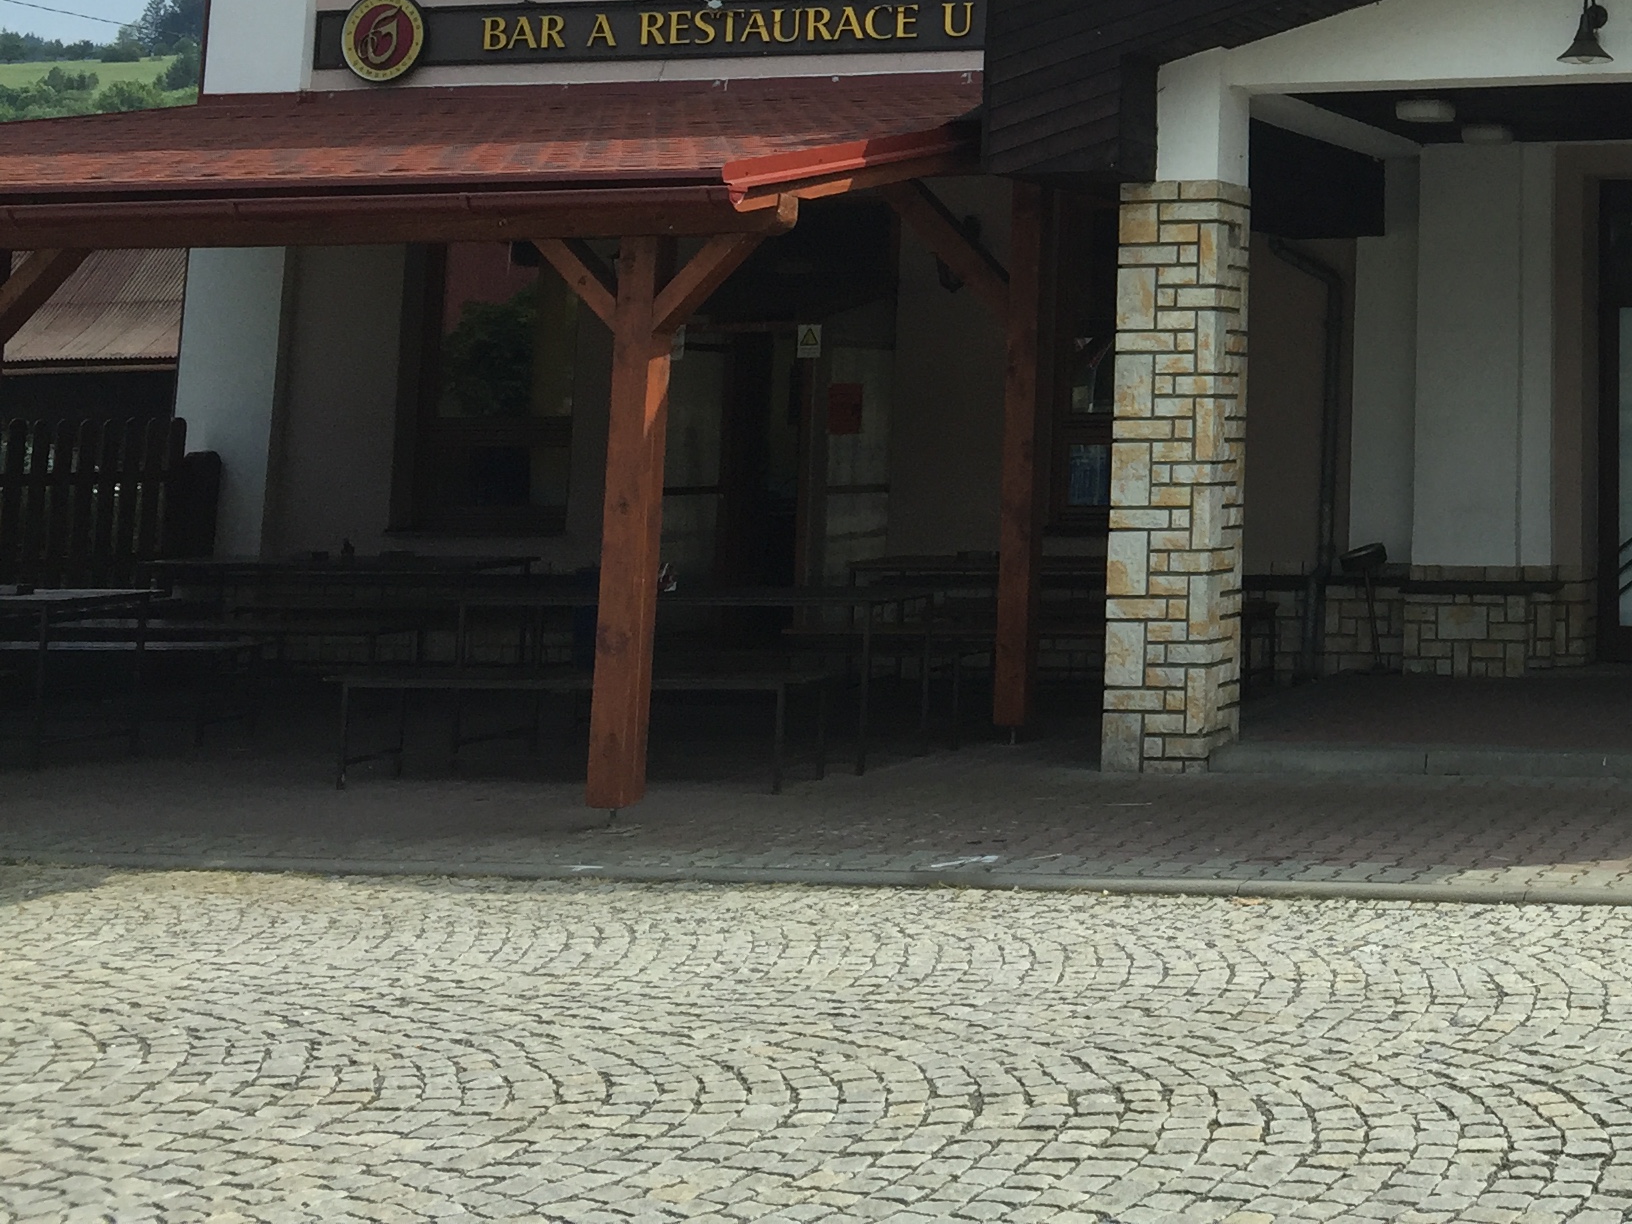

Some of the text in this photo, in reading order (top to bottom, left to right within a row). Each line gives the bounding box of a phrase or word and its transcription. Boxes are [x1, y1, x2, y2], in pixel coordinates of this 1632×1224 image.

[481, 1, 973, 52] BAR A RESTAURACE U
